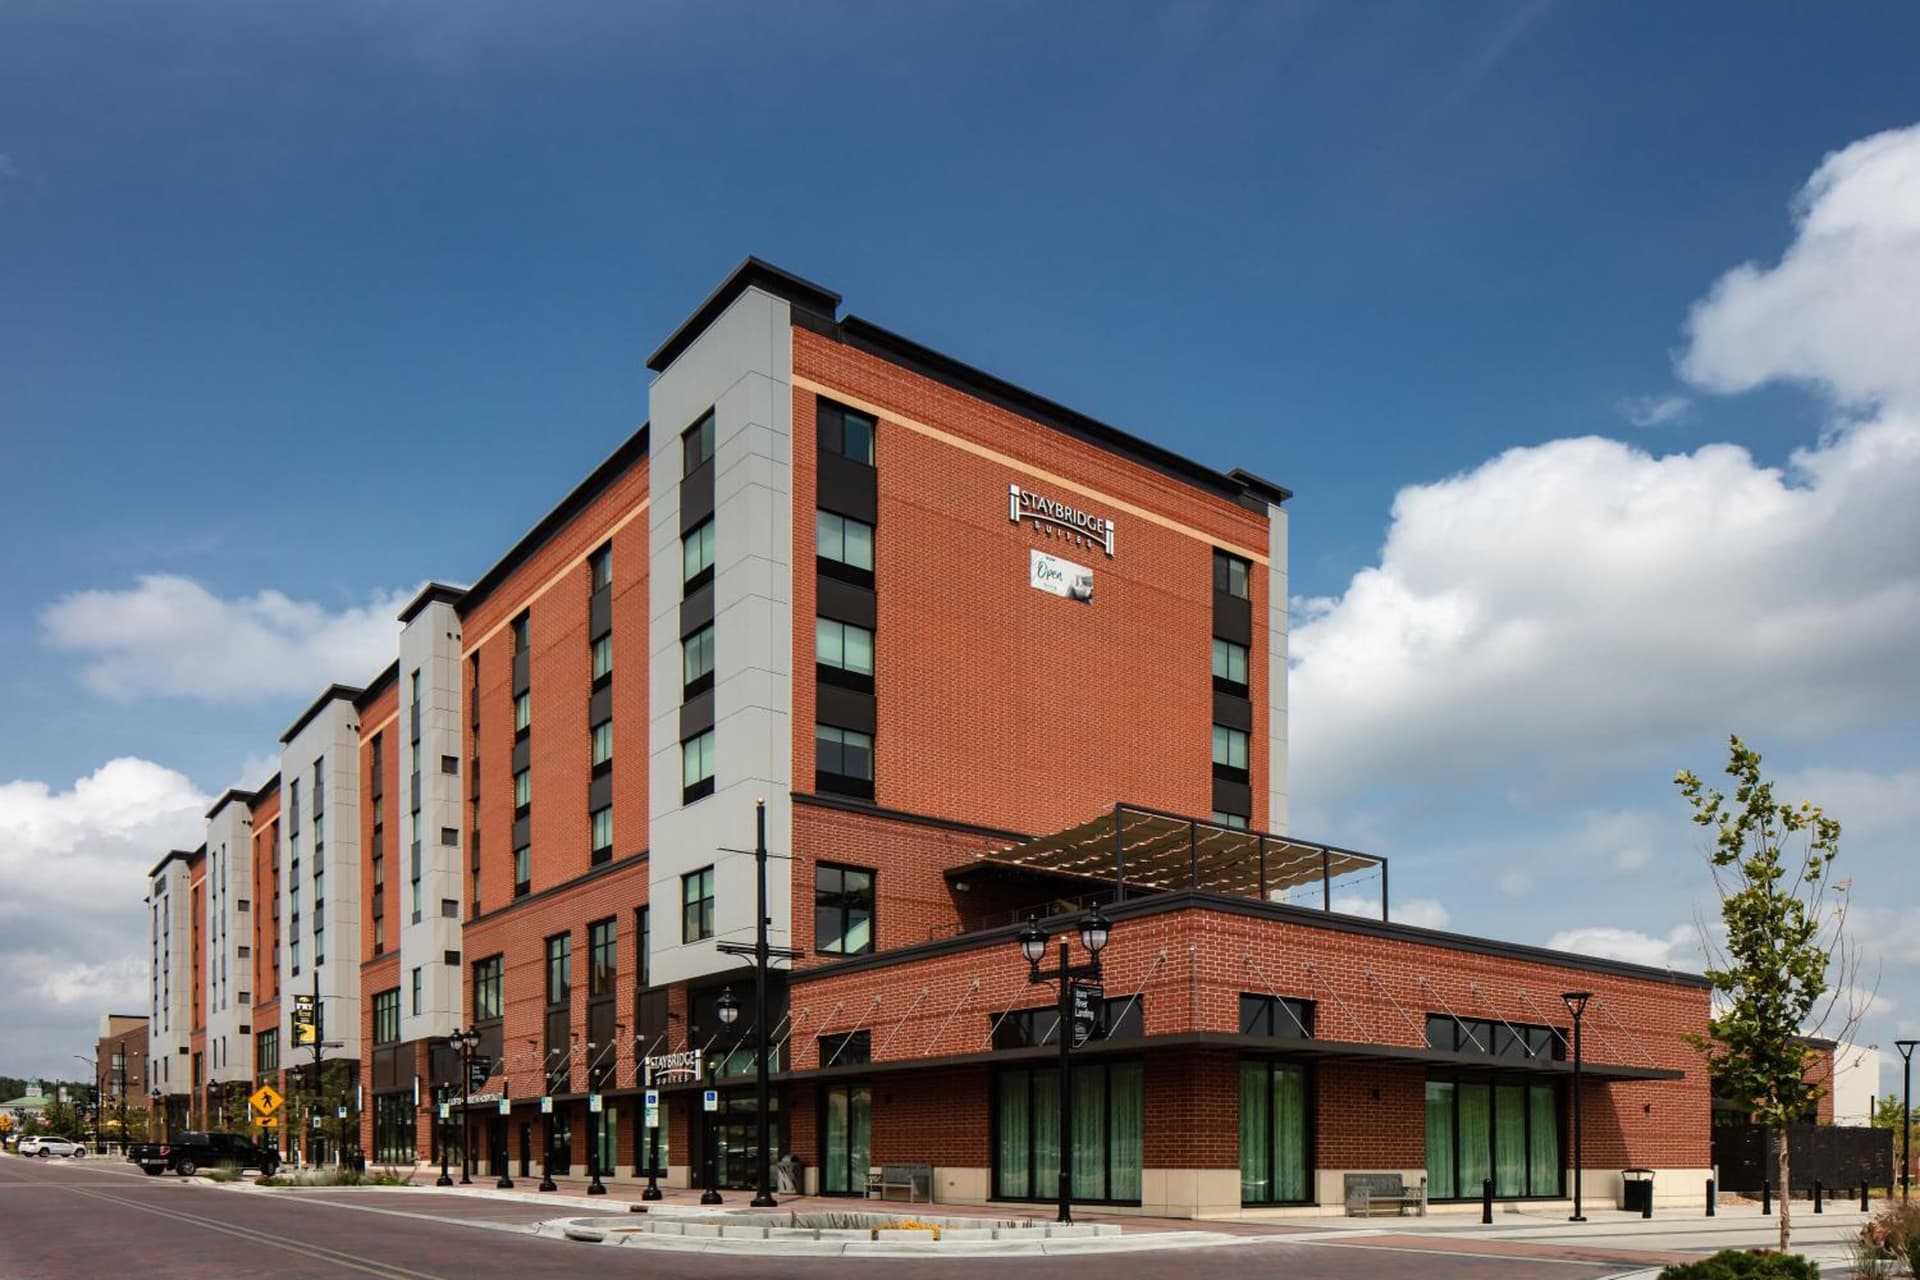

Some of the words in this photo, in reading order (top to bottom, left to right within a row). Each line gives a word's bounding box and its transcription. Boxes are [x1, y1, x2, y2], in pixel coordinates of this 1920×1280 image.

[1021, 491, 1104, 533] STAYBRIDGE
[1037, 560, 1063, 581] Open
[650, 1051, 695, 1070] STAYBRIDGE
